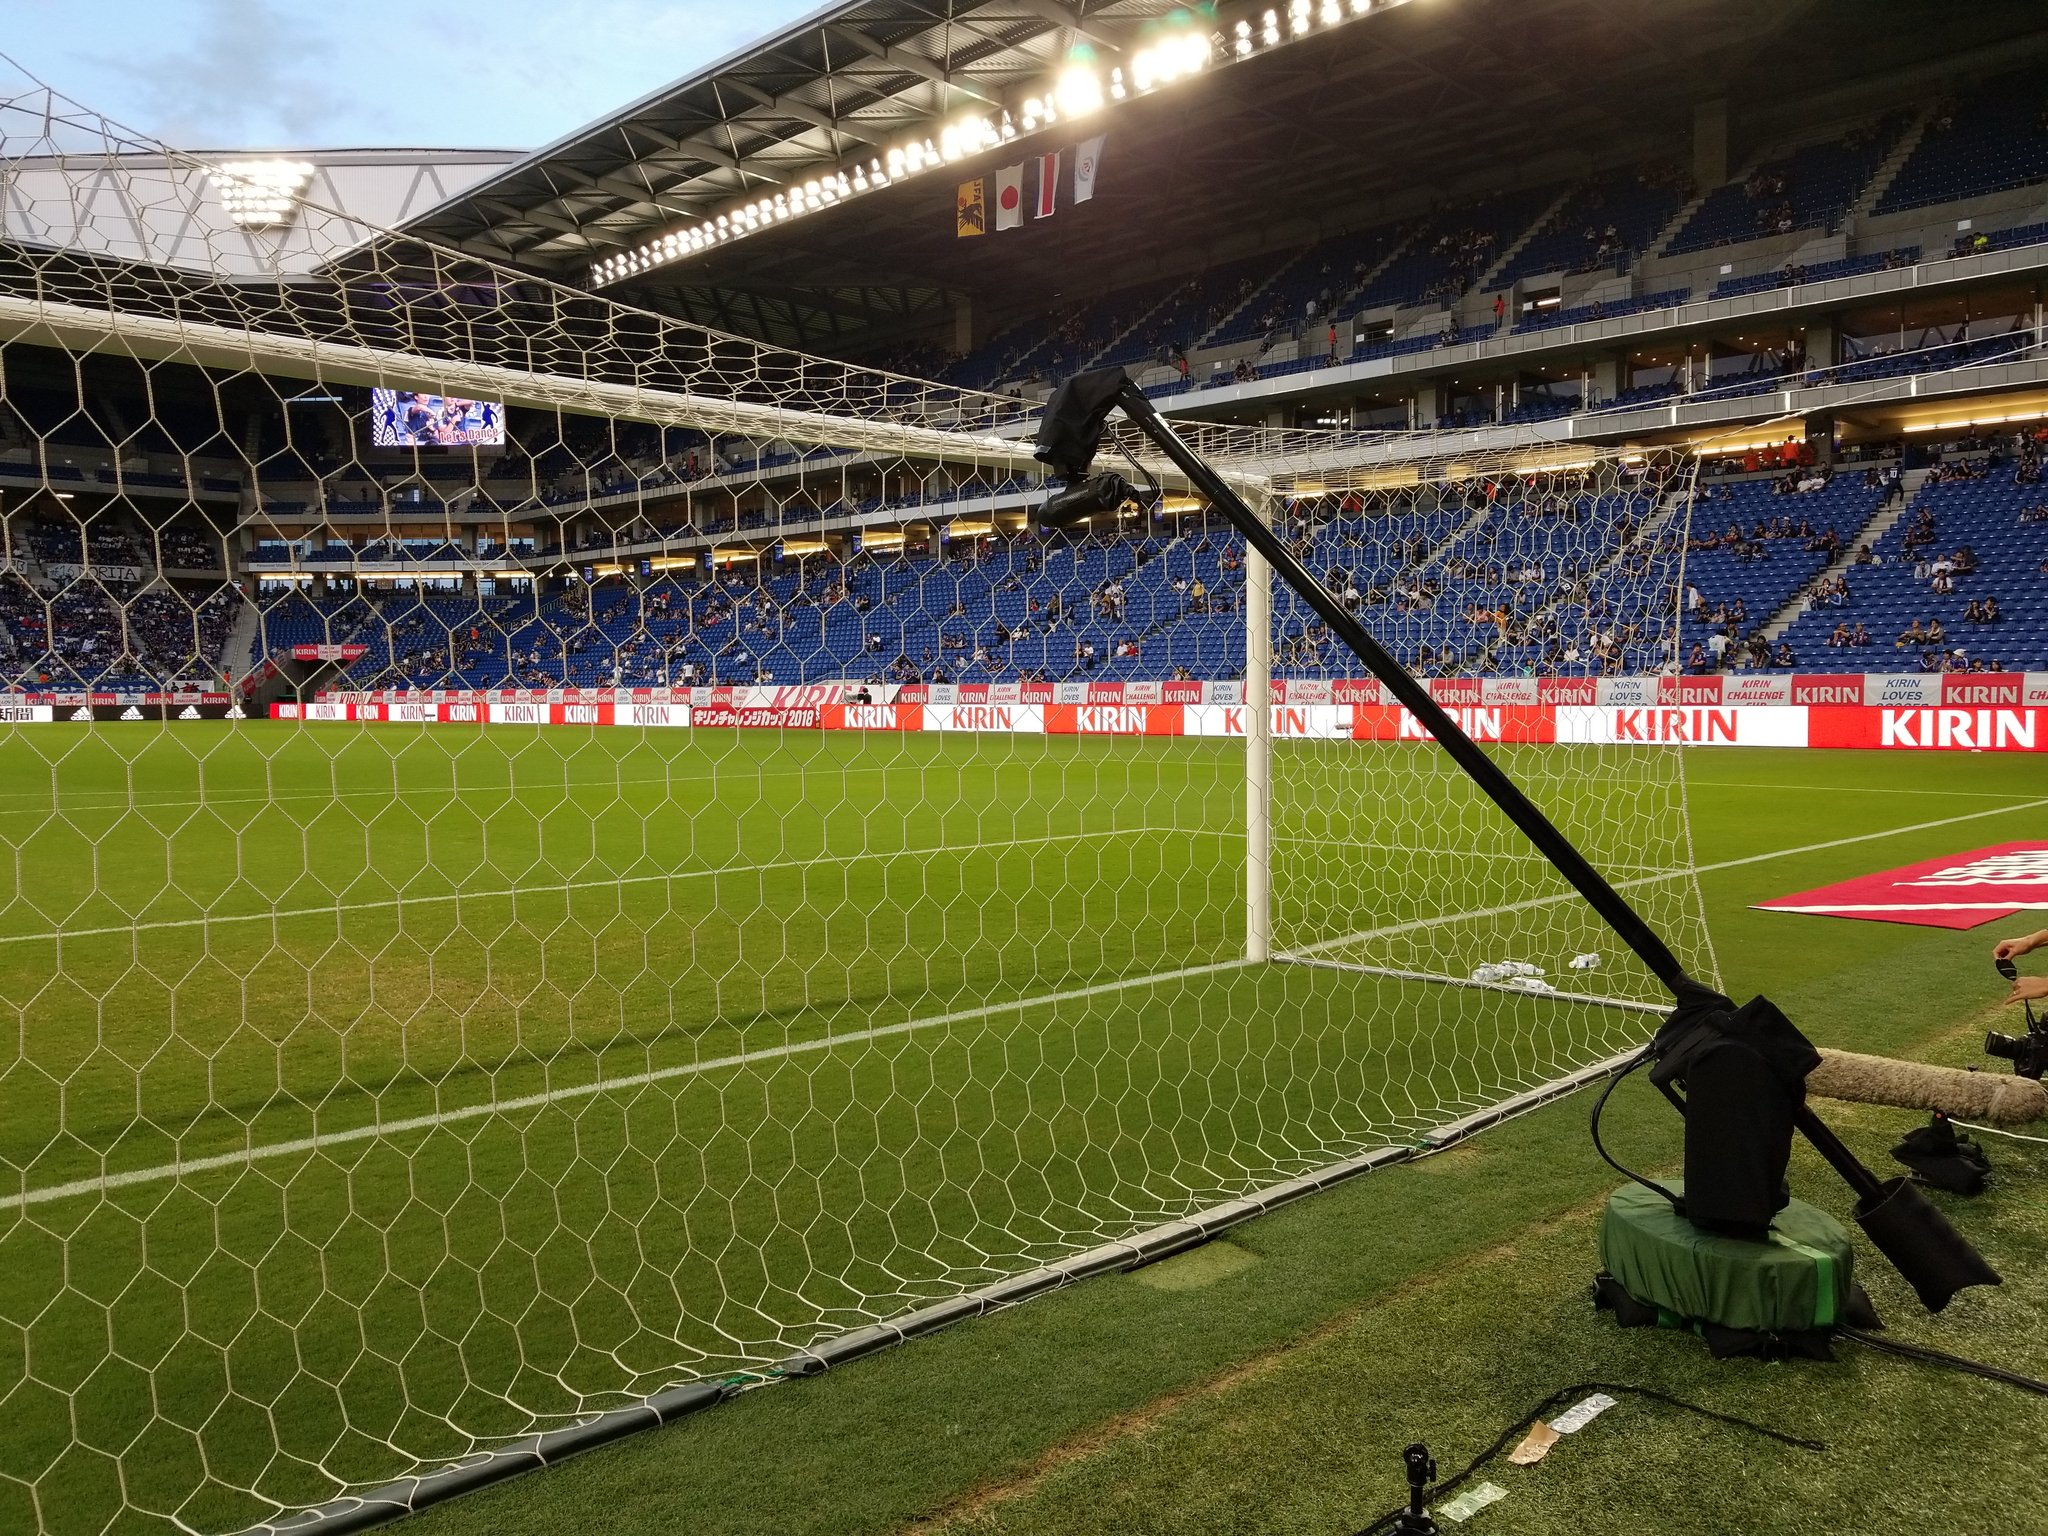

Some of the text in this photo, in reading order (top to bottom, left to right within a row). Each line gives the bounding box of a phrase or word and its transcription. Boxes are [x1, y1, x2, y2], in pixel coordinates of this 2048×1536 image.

[440, 428, 498, 444] Let's Dance
[1496, 682, 1520, 690] KIRIN
[1614, 681, 1641, 689] KIRIN
[1742, 680, 1772, 688] KIRIN
[1885, 679, 1921, 688] KIRIN
[146, 697, 172, 705] KIRN
[633, 694, 650, 702] KIRIN
[672, 694, 690, 702] KIRIN
[902, 692, 928, 703] KIRIN
[960, 692, 987, 703] KIRIN
[1022, 692, 1052, 703] KIRIN
[1089, 691, 1120, 703] KIRIN
[1165, 690, 1200, 702] KIRIN
[1335, 689, 1376, 702] KIRIN
[1434, 689, 1479, 703] KIRIN
[1540, 688, 1592, 703] KIRIN
[1610, 692, 1642, 700] LOVES
[1660, 688, 1718, 703] KIRIN
[1727, 691, 1785, 700] CHALLENGE
[1796, 687, 1859, 704] KIRIN
[1882, 691, 1923, 700] LOVES
[1946, 686, 2018, 704] KIRIN
[279, 705, 298, 718] KIRIN
[316, 705, 336, 718] KIRIN
[356, 705, 378, 719] KRIN
[401, 706, 424, 720] KIRIN
[450, 705, 477, 721] KIRIN
[505, 706, 534, 721] KIRIN
[565, 705, 598, 723] KIRIN
[634, 706, 669, 724] KRIN
[694, 710, 814, 727] キリンチャレンジカップ 2018
[845, 706, 896, 728] KIRIN
[953, 707, 1011, 729] KIRIN
[1077, 706, 1146, 732] KIRIN
[1225, 708, 1306, 733] KIN
[1400, 708, 1499, 738] KRIN
[1616, 709, 1737, 742] KIRIN
[1881, 710, 2035, 748] KIRIN
